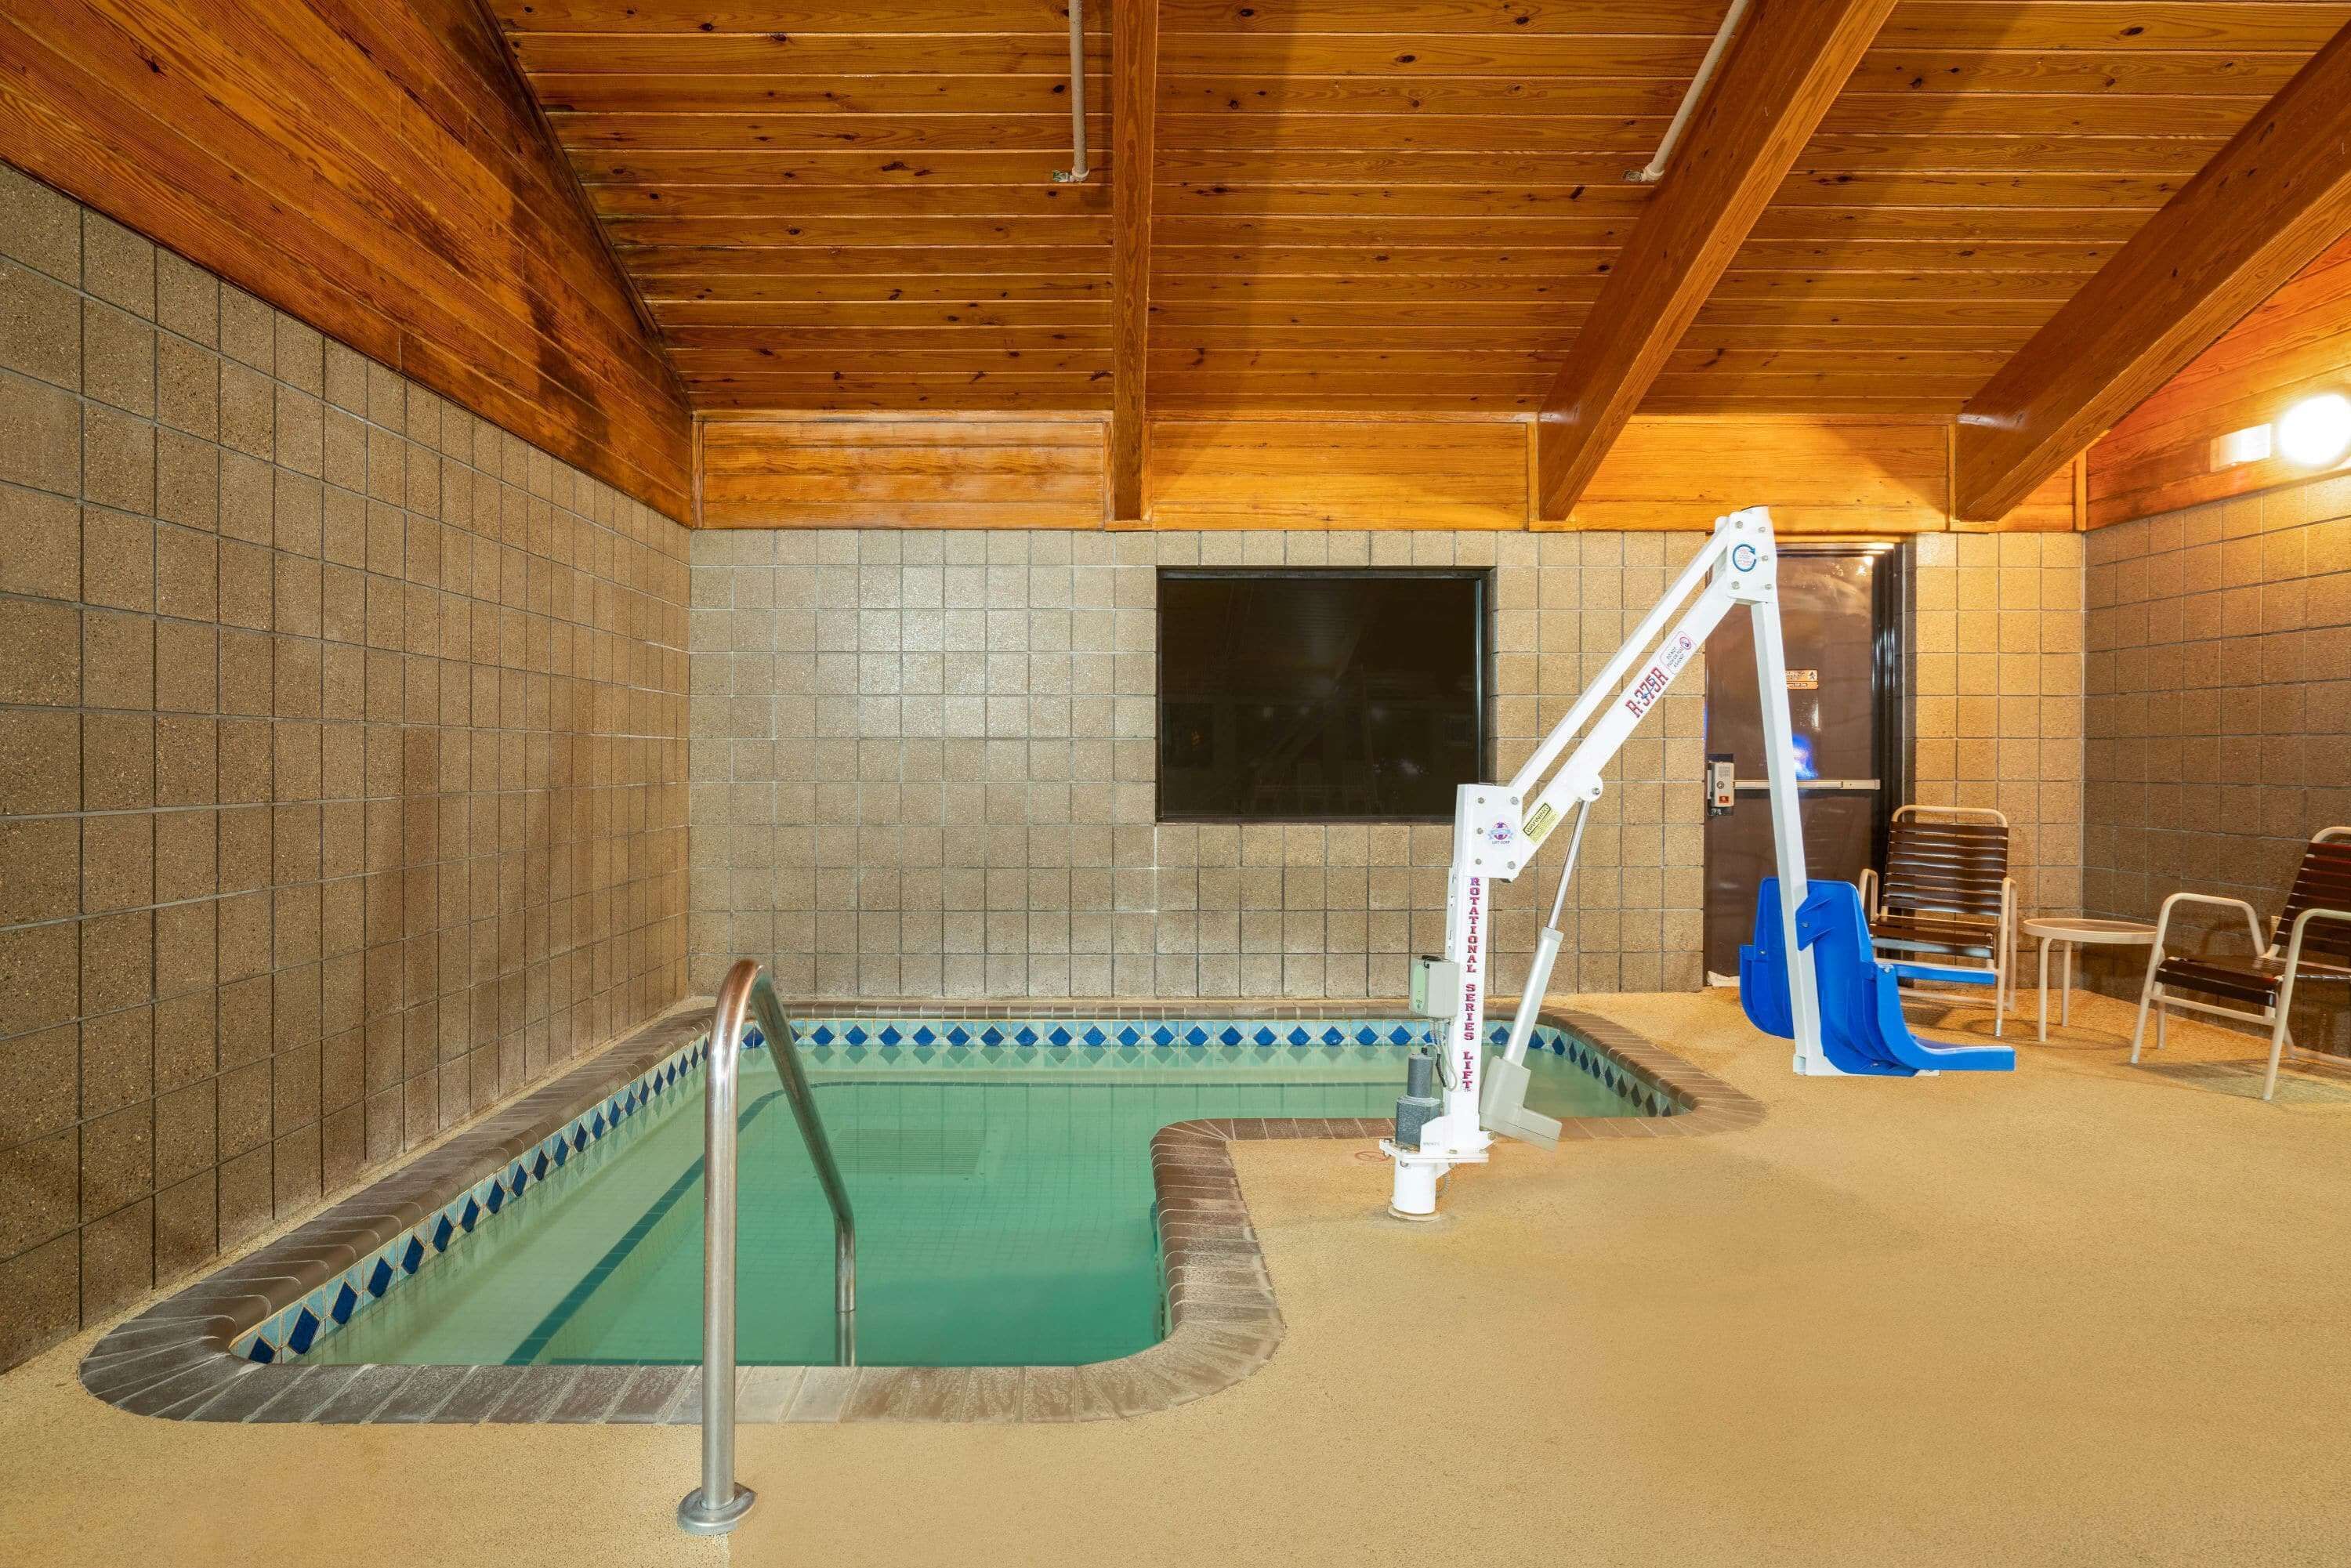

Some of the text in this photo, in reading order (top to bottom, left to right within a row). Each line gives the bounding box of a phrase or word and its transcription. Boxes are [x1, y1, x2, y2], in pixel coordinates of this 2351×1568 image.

[1525, 806, 1549, 833] WARNING
[1462, 878, 1480, 1089] ROTATIONAL SERIES LIFT
